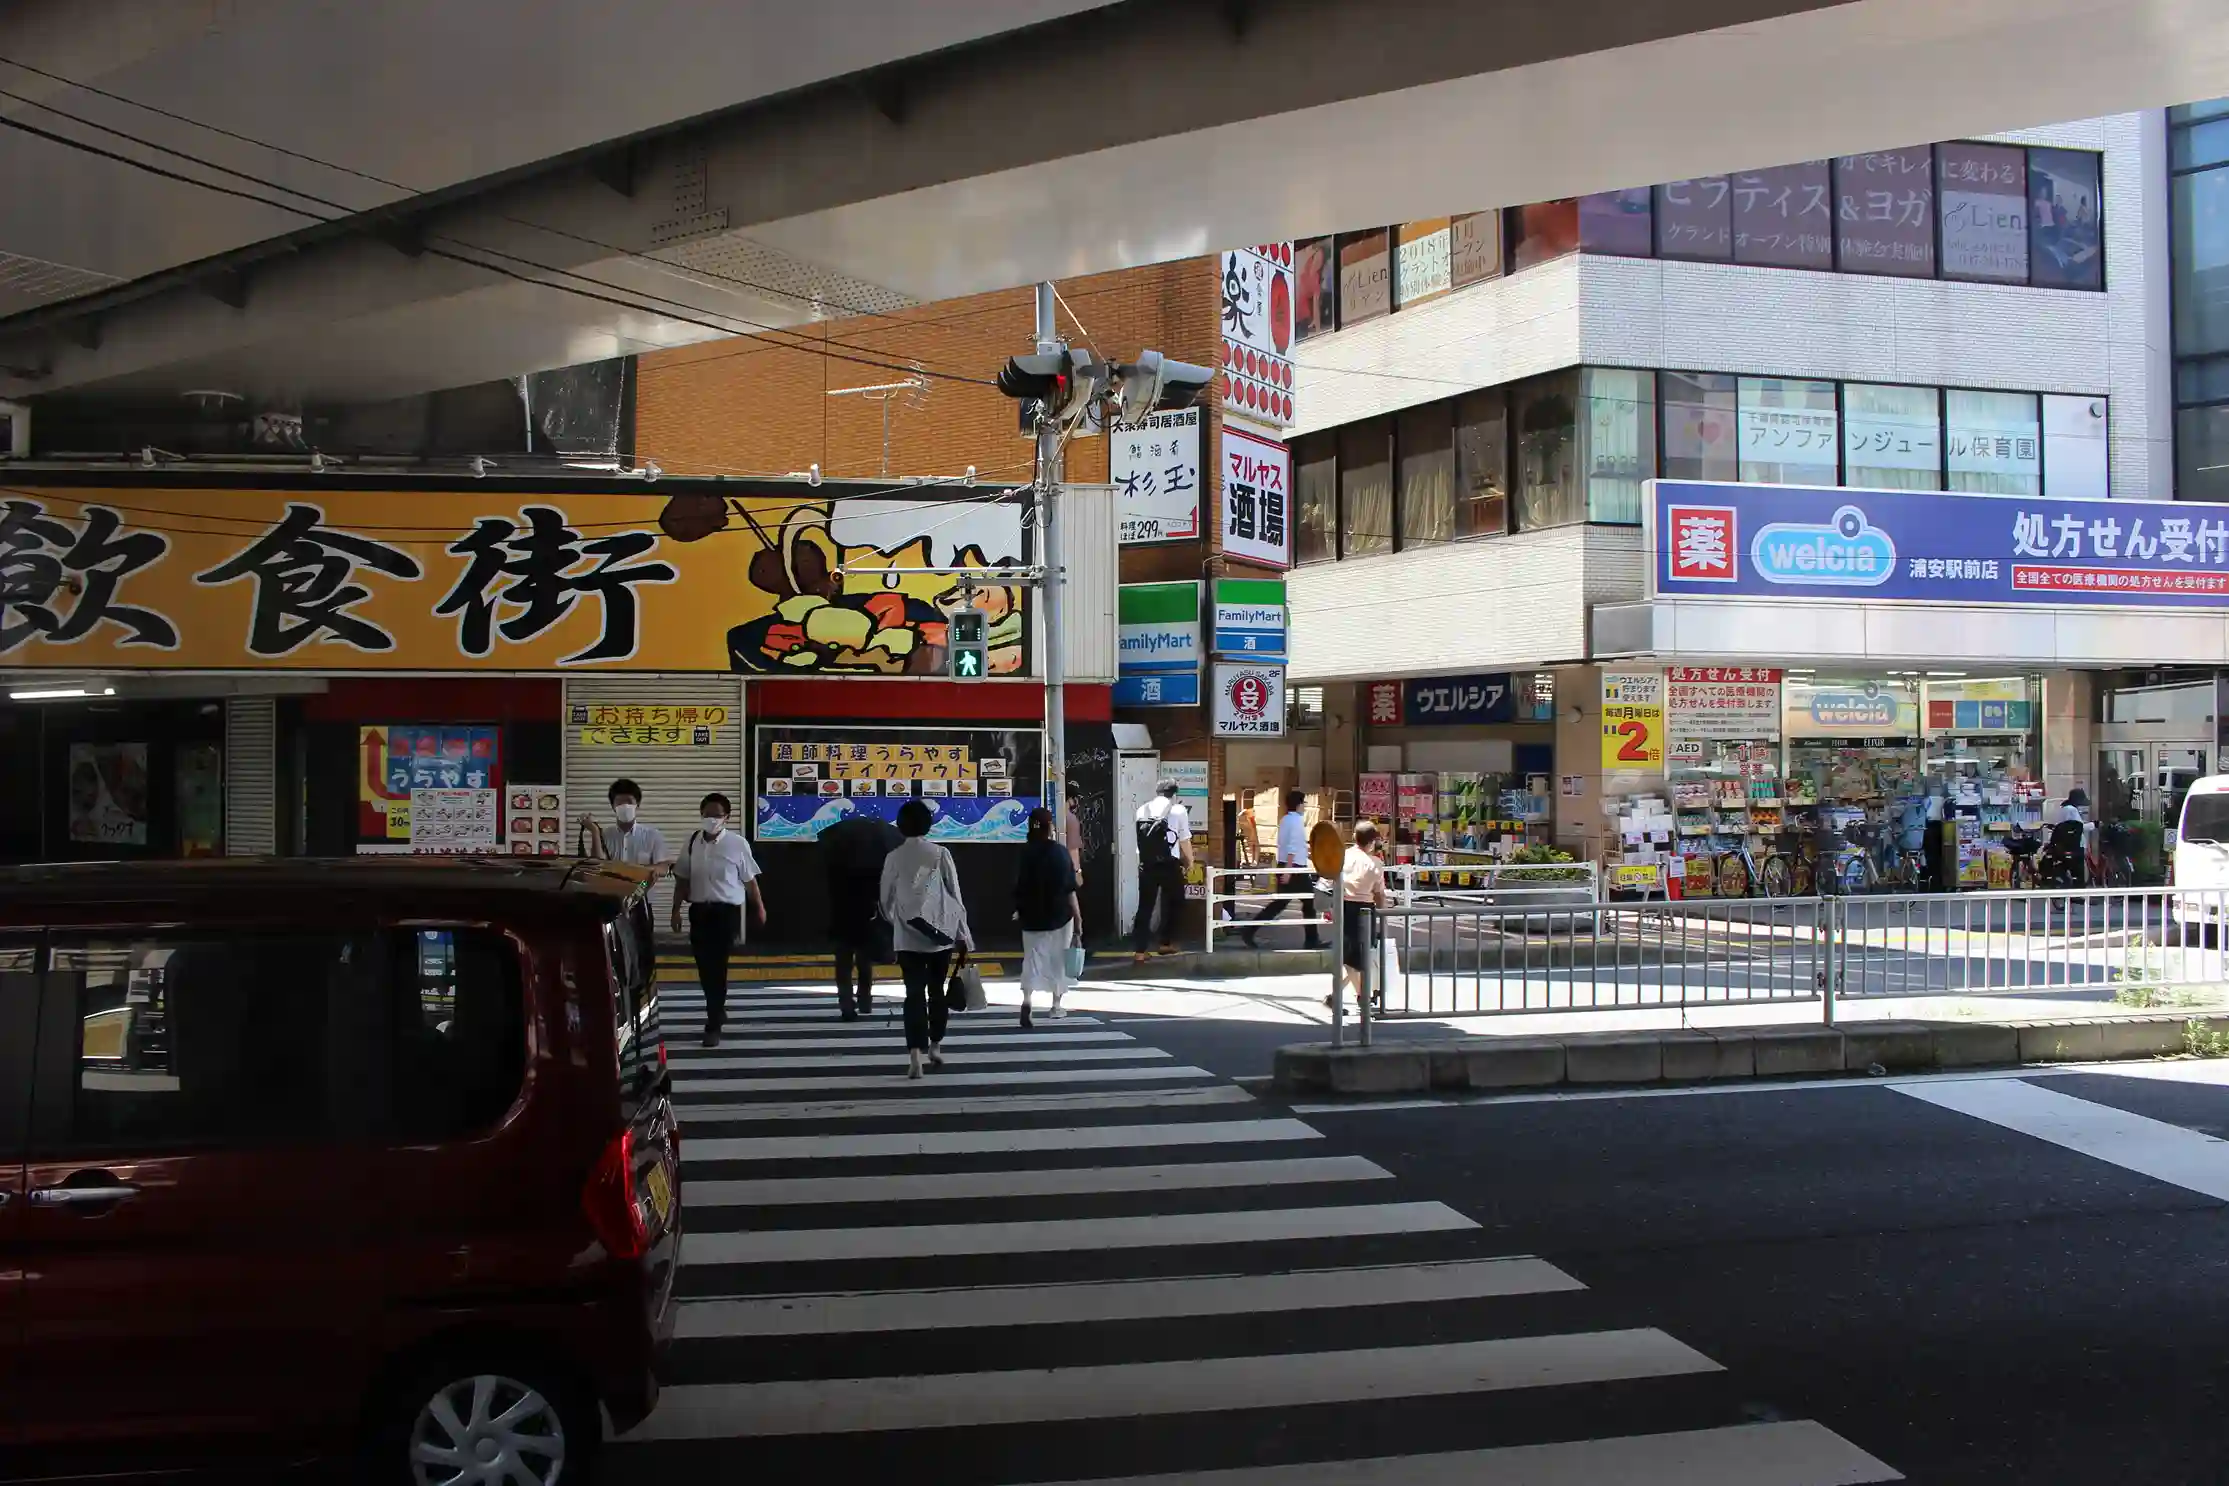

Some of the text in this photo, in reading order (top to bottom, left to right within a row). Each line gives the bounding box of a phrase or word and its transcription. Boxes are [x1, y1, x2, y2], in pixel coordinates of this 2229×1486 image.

[1114, 463, 1196, 498] 杉玉
[1229, 452, 1283, 491] マルヤス
[1229, 483, 1284, 547] 酒場
[1678, 516, 1728, 571] 薬
[2012, 510, 2229, 564] 処方せん受付
[1768, 539, 1877, 573] welcia
[1909, 557, 2000, 580] 浦安駅前店
[2016, 571, 2228, 590] 全国全ての医療機関の処方せんを受付ます
[1218, 609, 1282, 623] FamilyMart
[1119, 633, 1192, 653] amilyMart
[1243, 636, 1256, 650] 酒
[1671, 667, 1771, 682] 処方せん受付
[1140, 678, 1161, 701] 酒
[1416, 684, 1504, 713] ウエルシア
[1668, 686, 1775, 697] 全国すべての医療機関の
[1372, 684, 1396, 722] 薬
[595, 706, 725, 725] お持ち帰り
[583, 725, 686, 744] できます
[1218, 721, 1280, 732] マルヤス酒場
[1616, 720, 1649, 762] 2
[1675, 742, 1699, 754] AED
[776, 744, 963, 761] 漁師料理うらやす
[391, 768, 486, 789] うらやす
[835, 762, 970, 778] テイクアウト
